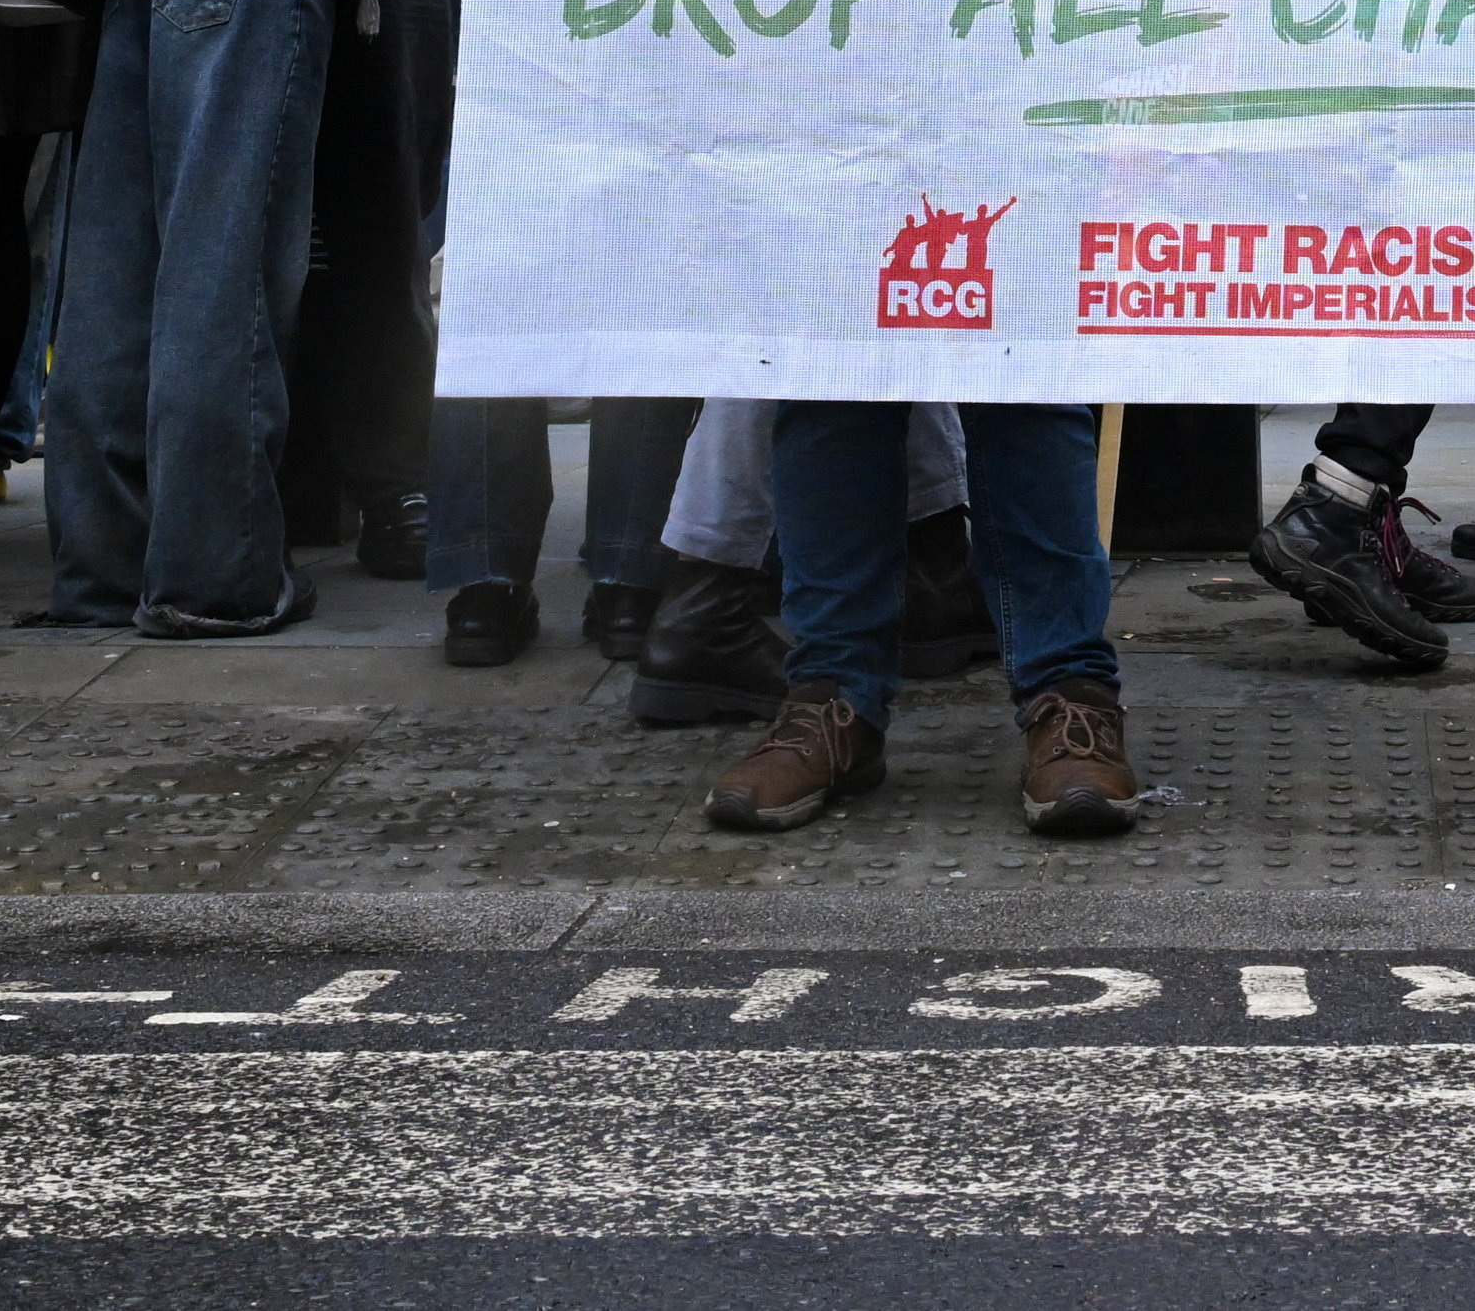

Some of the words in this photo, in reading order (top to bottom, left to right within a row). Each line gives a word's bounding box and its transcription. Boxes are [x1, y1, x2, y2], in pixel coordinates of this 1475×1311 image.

[1079, 221, 1268, 275] FIGHT
[883, 281, 987, 320] RCG
[1078, 281, 1219, 320] FIGHT
